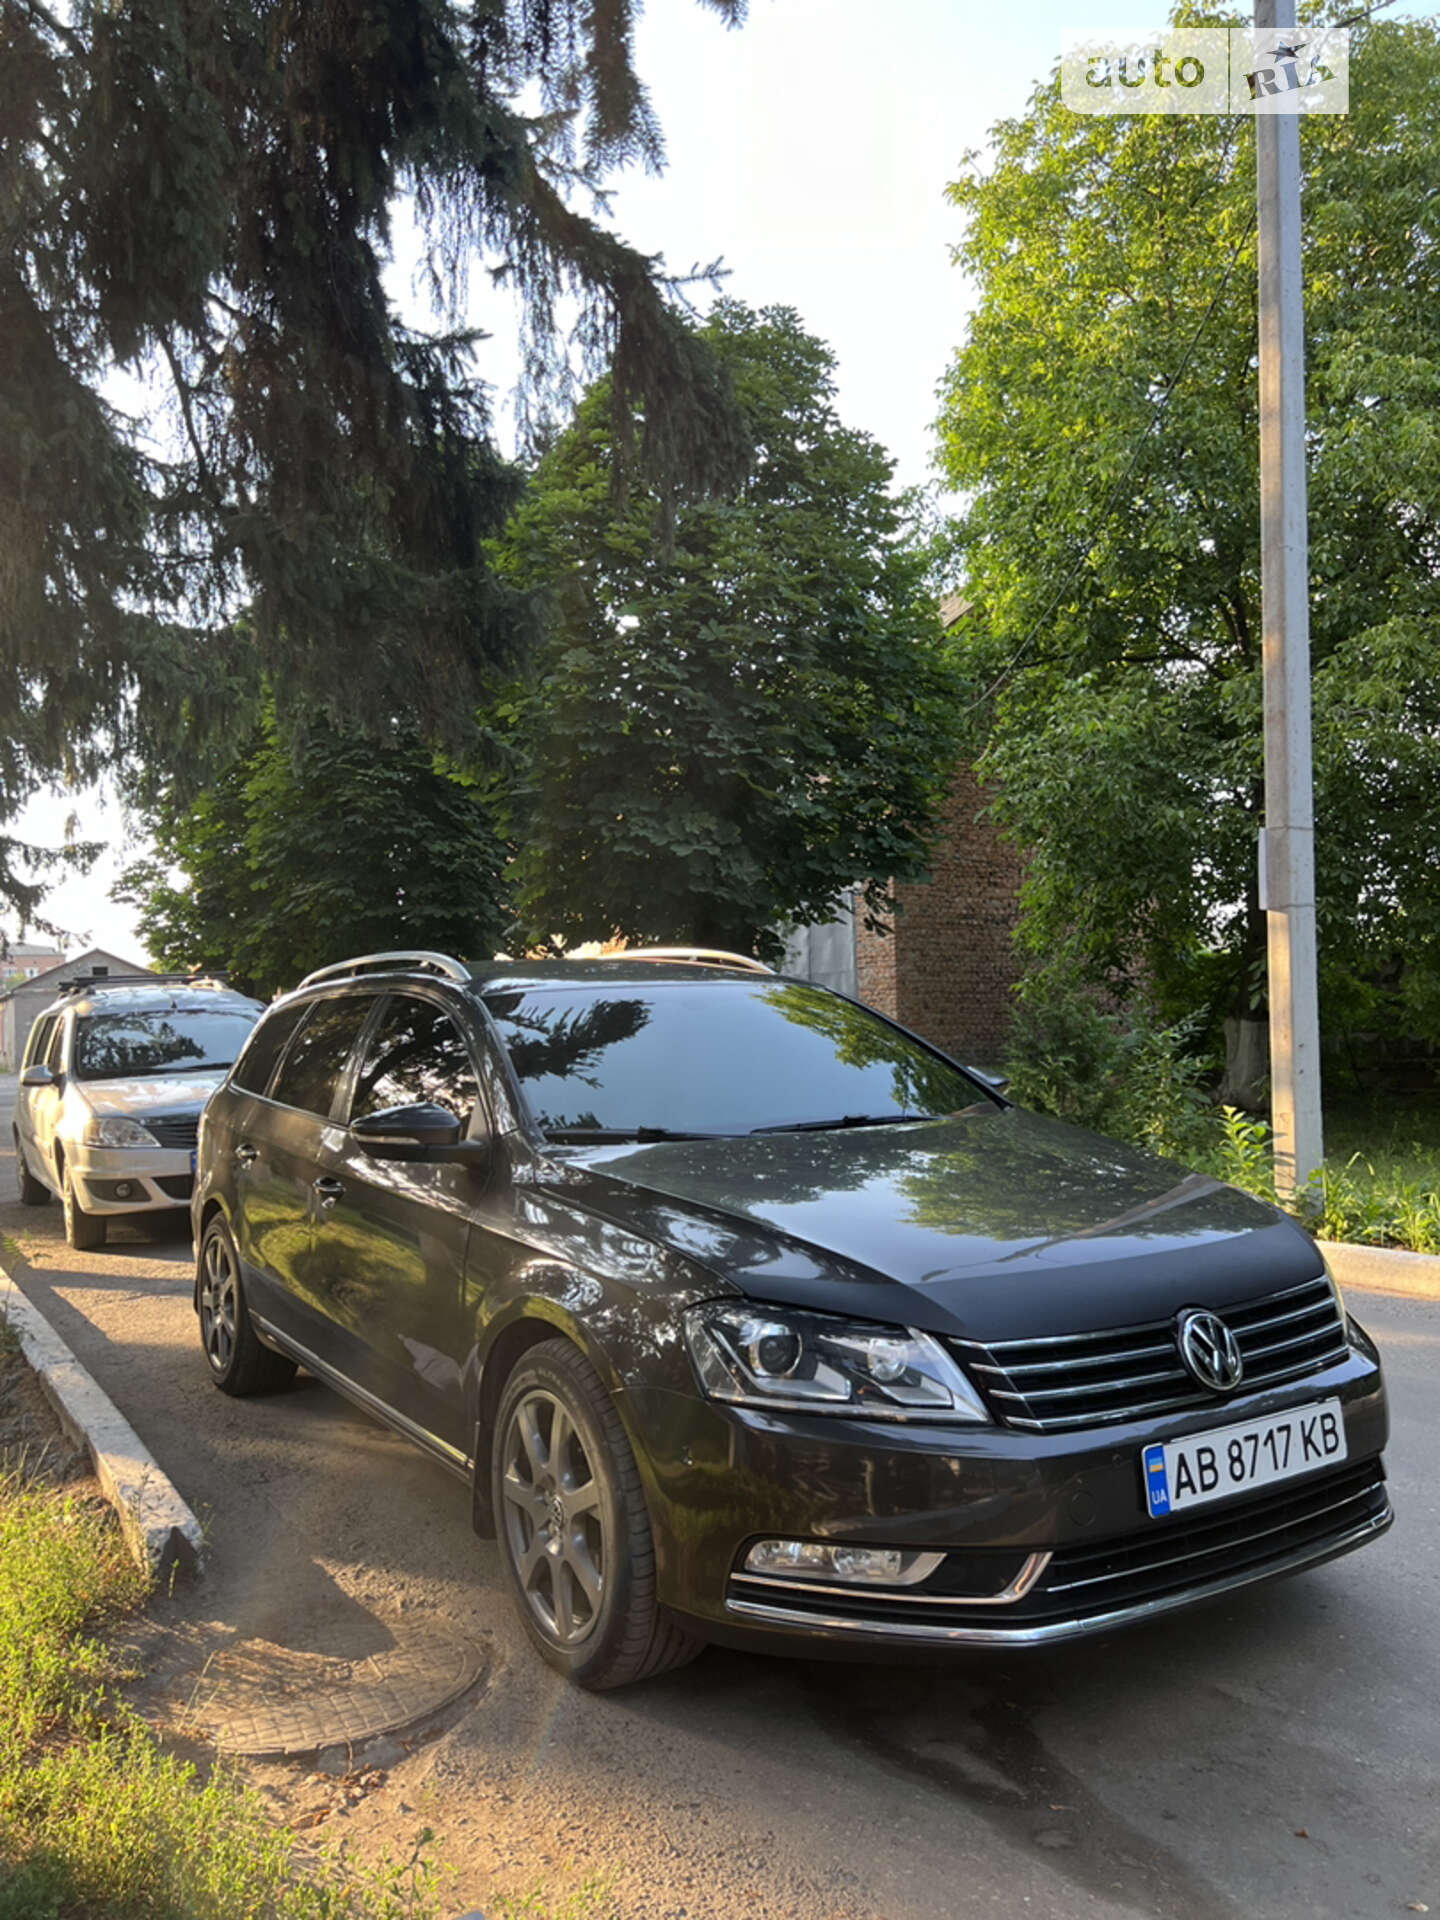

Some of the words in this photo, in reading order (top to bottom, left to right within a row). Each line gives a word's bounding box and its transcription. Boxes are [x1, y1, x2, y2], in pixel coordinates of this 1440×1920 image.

[1175, 1447, 1219, 1499] AB
[1227, 1424, 1292, 1483] 8717
[1300, 1412, 1340, 1462] KB
[1152, 1490, 1168, 1504] UA
